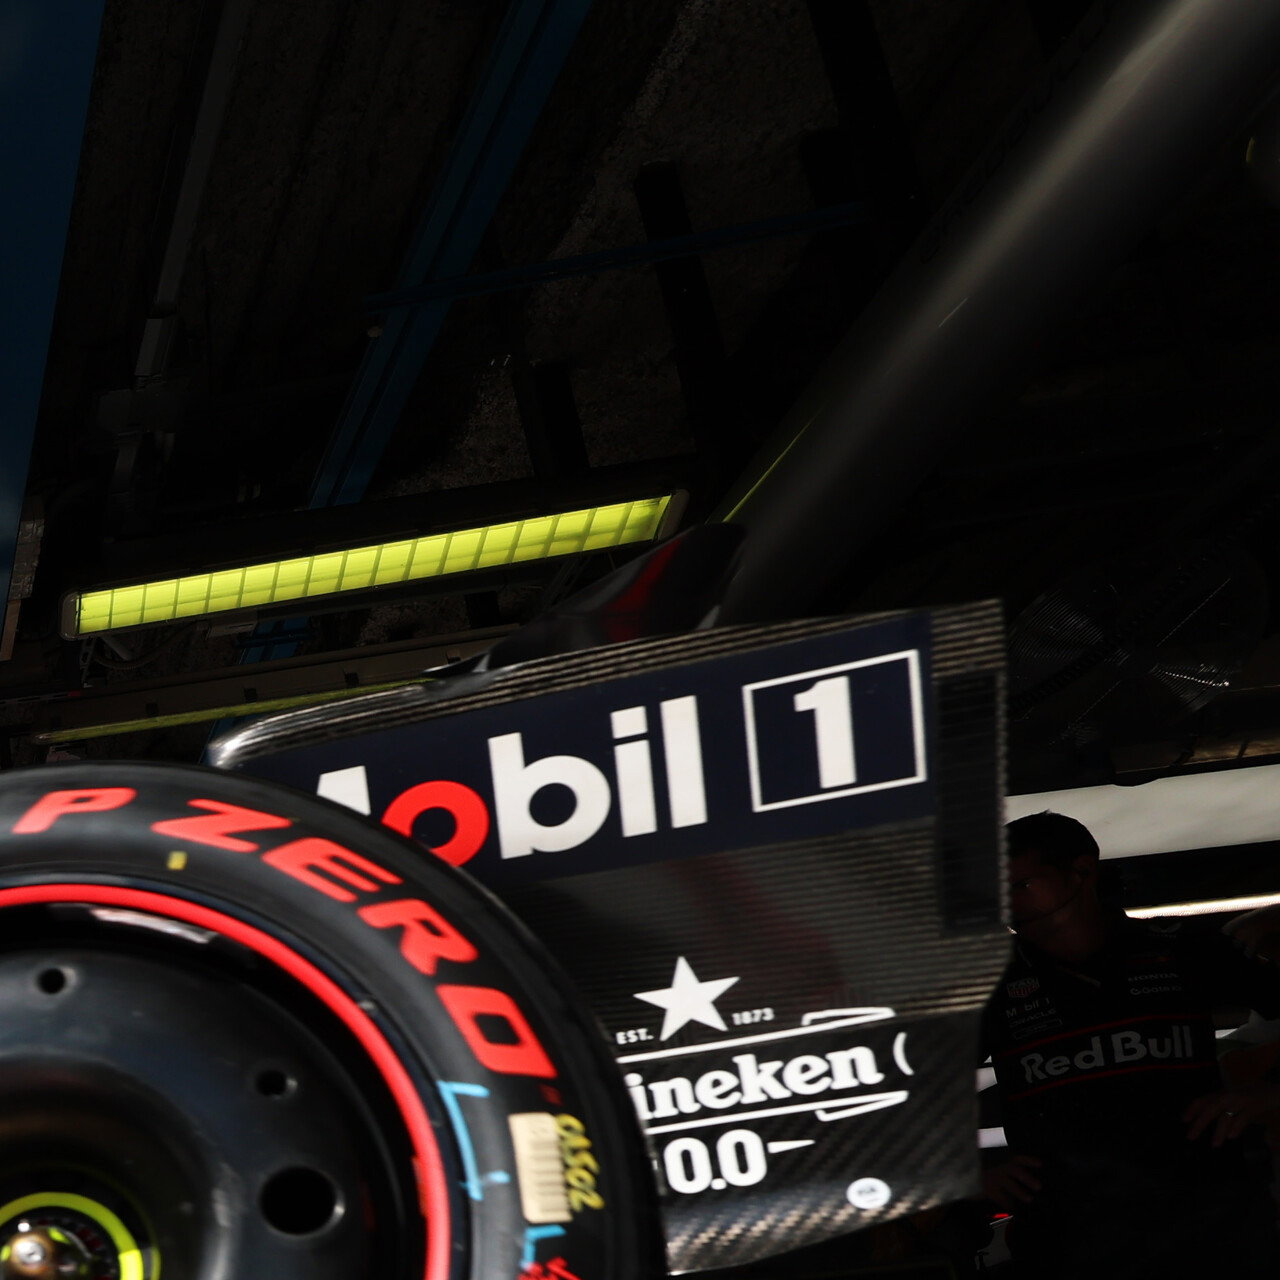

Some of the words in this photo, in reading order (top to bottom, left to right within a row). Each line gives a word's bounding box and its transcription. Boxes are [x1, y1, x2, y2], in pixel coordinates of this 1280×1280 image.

[794, 676, 858, 789] 1
[13, 787, 137, 836] P
[151, 799, 558, 1079] ZERO
[616, 1027, 654, 1045] EST.
[1020, 1034, 1106, 1085] Red
[1111, 1025, 1193, 1064] Bull
[663, 1128, 768, 1194] 0.0
